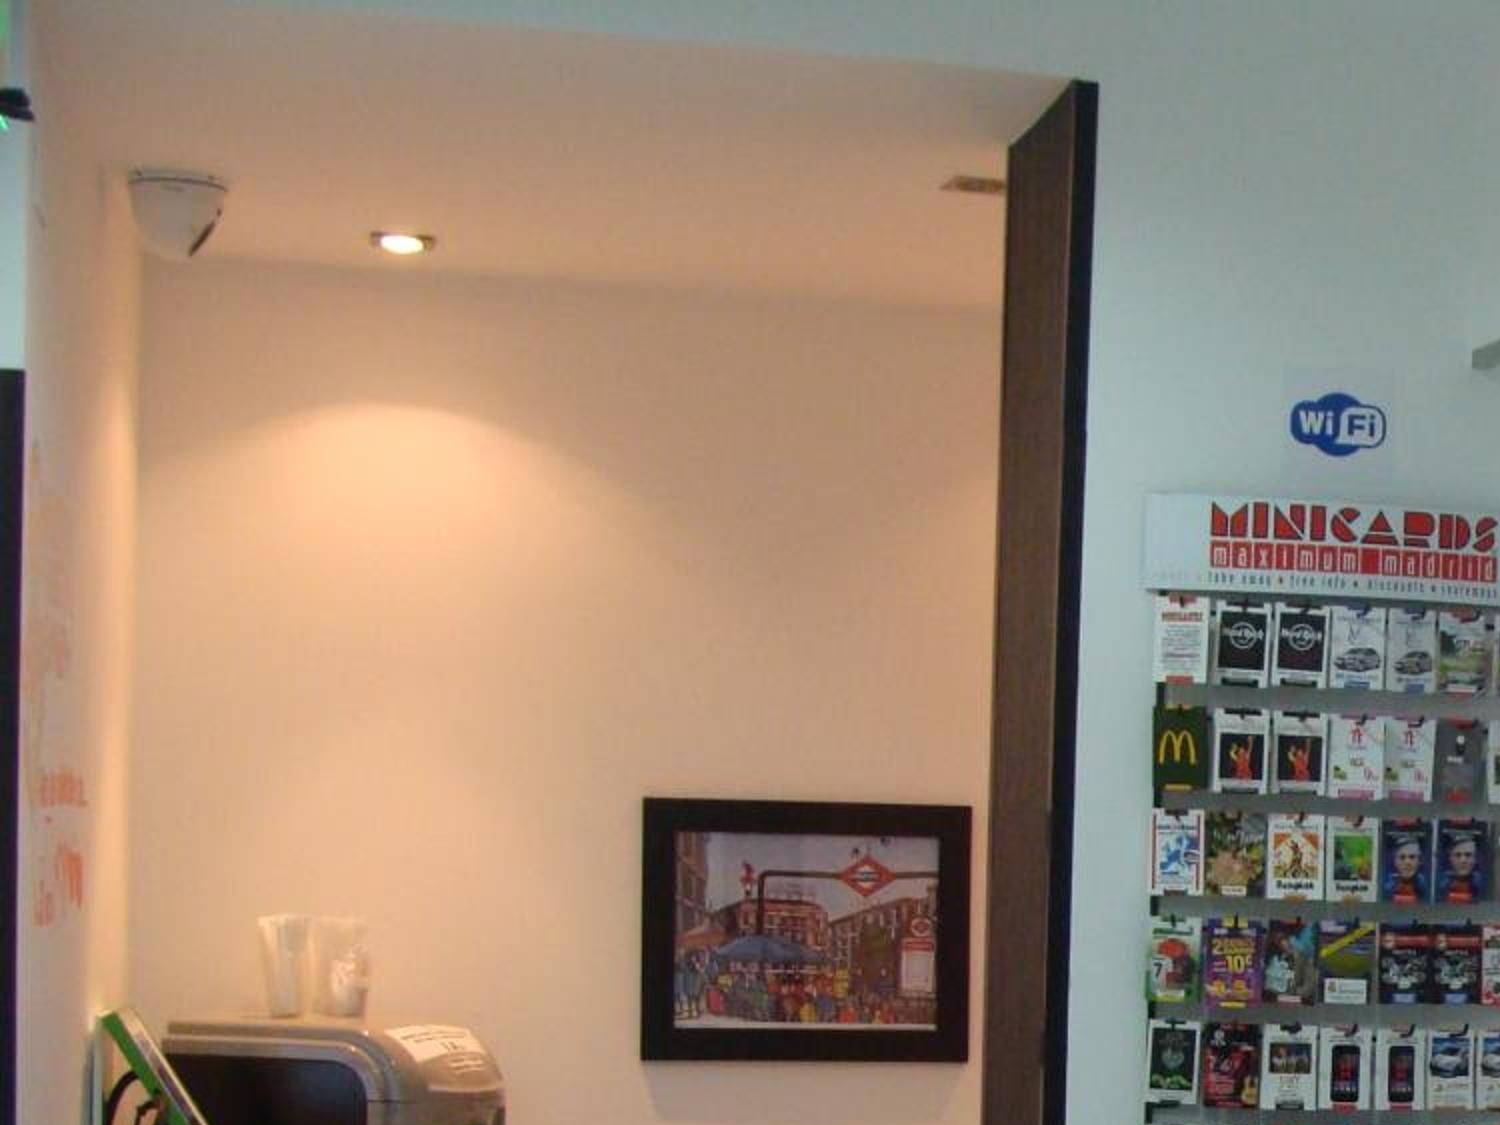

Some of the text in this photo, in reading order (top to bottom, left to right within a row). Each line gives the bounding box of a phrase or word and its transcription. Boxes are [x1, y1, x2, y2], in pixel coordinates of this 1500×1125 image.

[1210, 501, 1498, 552] MINICARDS
[1212, 545, 1494, 581] maximum madrid
